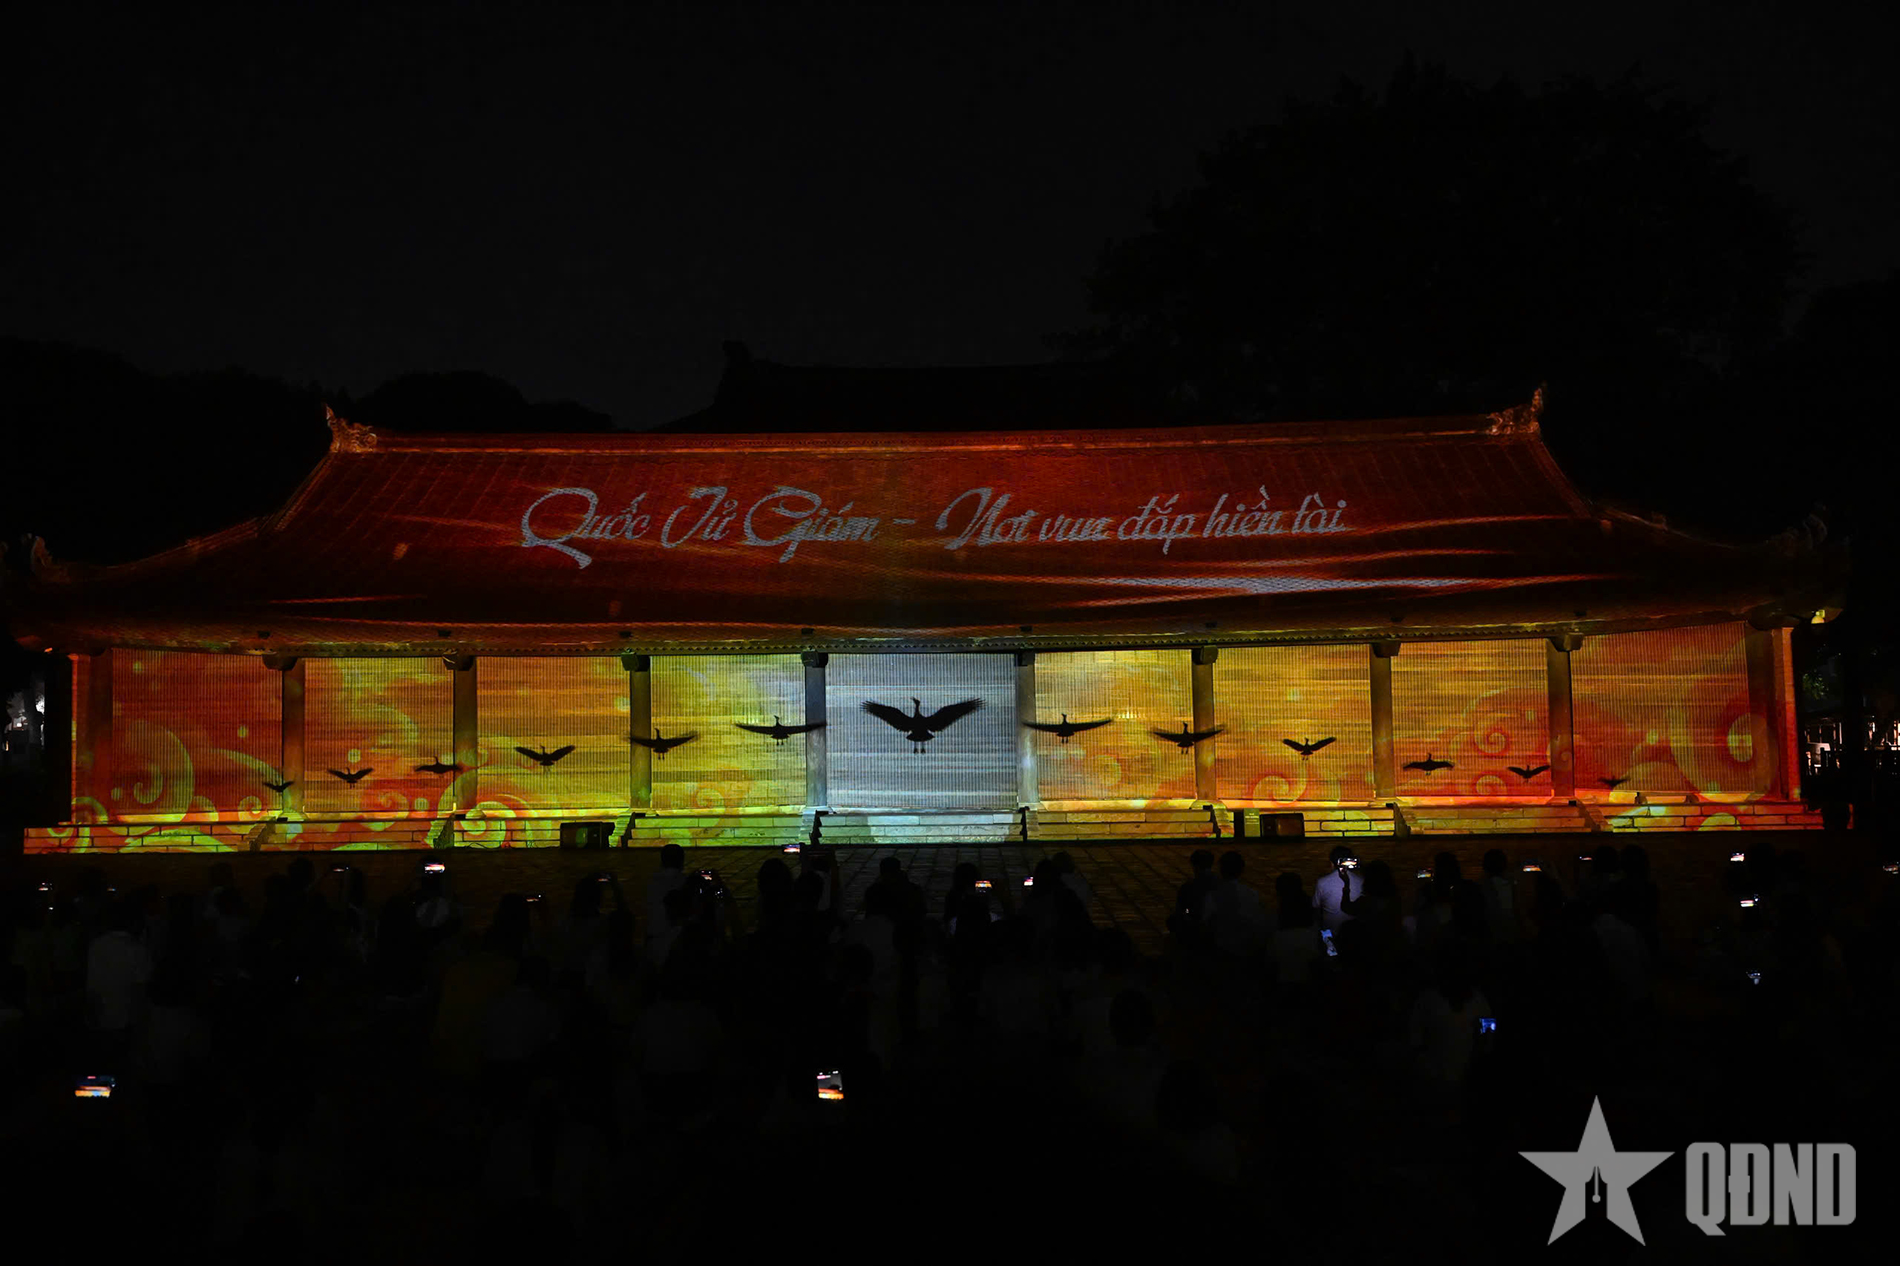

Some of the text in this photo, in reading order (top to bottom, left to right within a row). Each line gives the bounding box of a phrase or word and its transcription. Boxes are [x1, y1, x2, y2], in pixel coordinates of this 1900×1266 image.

[521, 487, 651, 569] Quốc
[661, 486, 739, 548] Tử
[740, 485, 880, 563] Giám
[1039, 514, 1113, 542] vun
[1117, 493, 1200, 555] đắp
[1203, 485, 1289, 538] hiền
[1291, 491, 1350, 534] tài
